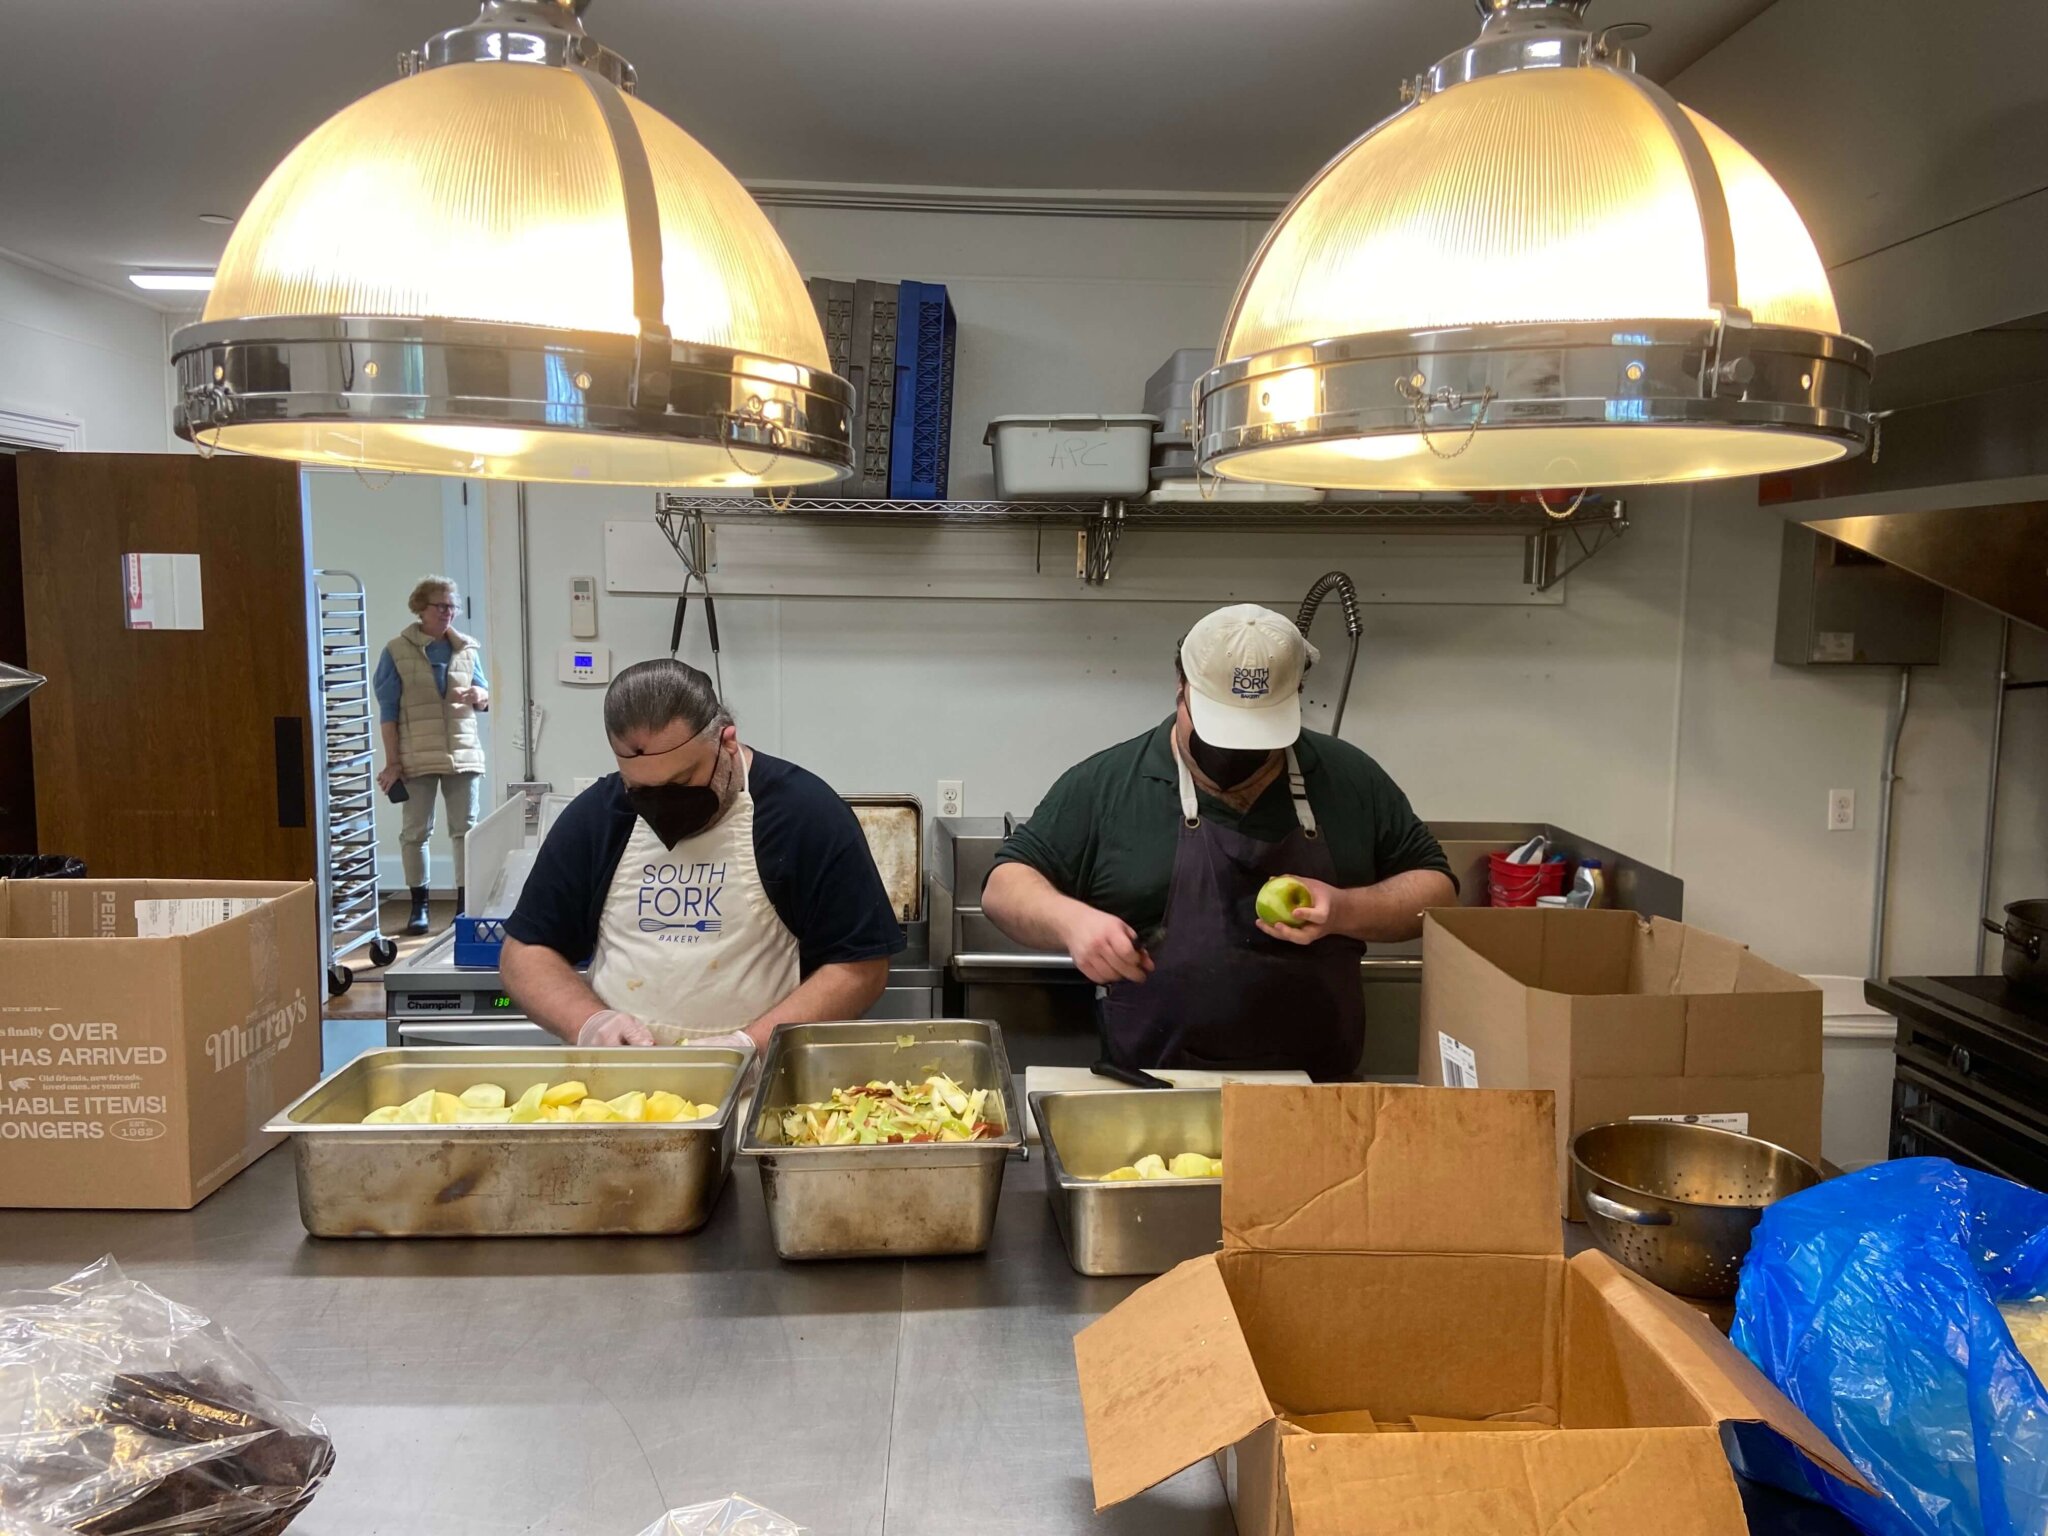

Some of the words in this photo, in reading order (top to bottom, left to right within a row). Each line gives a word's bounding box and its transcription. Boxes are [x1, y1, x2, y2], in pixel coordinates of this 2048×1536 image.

[1233, 667, 1269, 677] SOUTH
[1232, 676, 1269, 690] FORK
[642, 862, 727, 885] SOUTH
[637, 886, 723, 917] FORK
[658, 934, 700, 944] BAKERY
[407, 1000, 461, 1010] Champion
[7, 1026, 45, 1039] finally
[49, 1022, 118, 1042] OVER
[205, 987, 307, 1073] Murray's
[1, 1047, 52, 1066] HAS
[58, 1046, 168, 1066] ARRIVED
[42, 1083, 66, 1091] loved
[85, 1096, 167, 1114] ITEMS!
[0, 1121, 105, 1139] ONGERS
